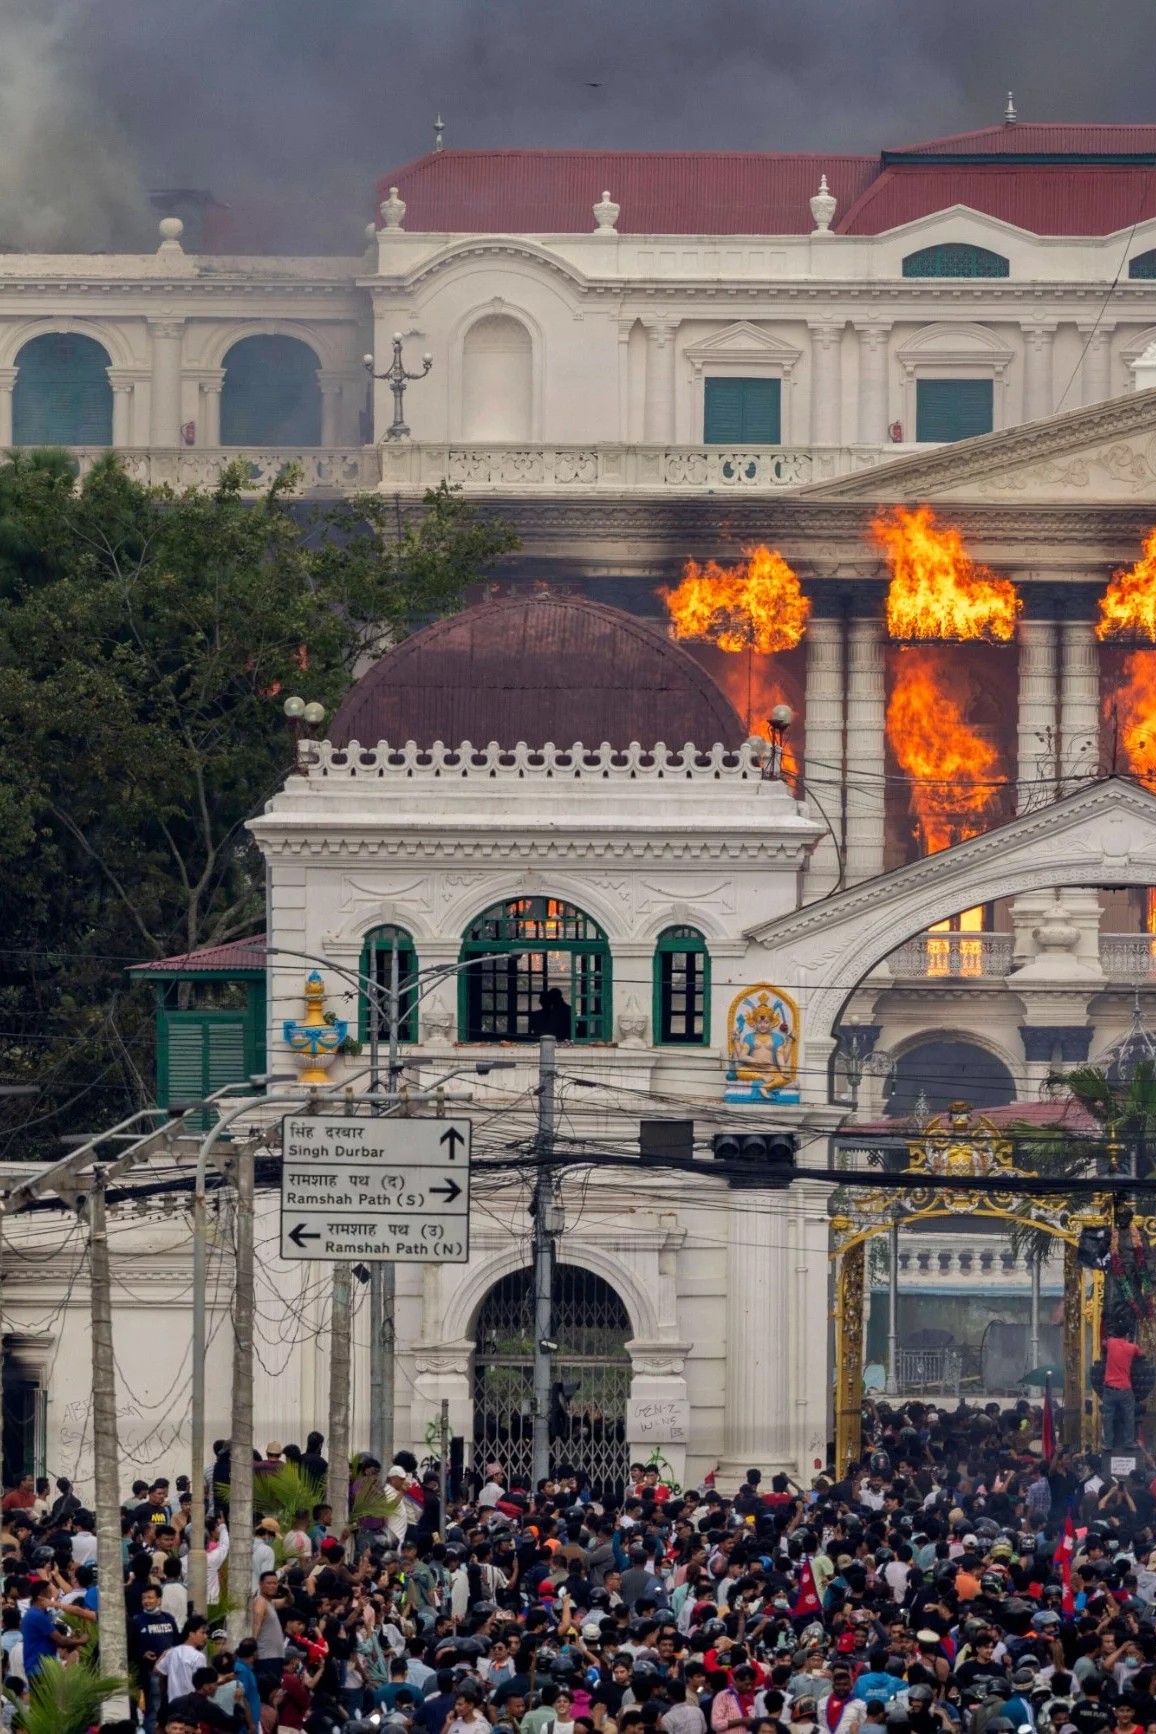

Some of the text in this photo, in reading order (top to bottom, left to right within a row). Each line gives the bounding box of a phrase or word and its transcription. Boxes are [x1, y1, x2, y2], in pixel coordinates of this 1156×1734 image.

[290, 1122, 314, 1139] सिंह
[289, 1145, 385, 1158] Singh Durbar
[289, 1174, 405, 1191] रामशाह पथ (द)
[287, 1193, 352, 1206] Ramshah
[359, 1194, 391, 1206] Path
[327, 1223, 445, 1240] रामशाह पथ (उ)
[325, 1241, 390, 1254] Ramshah
[396, 1242, 428, 1255] Path
